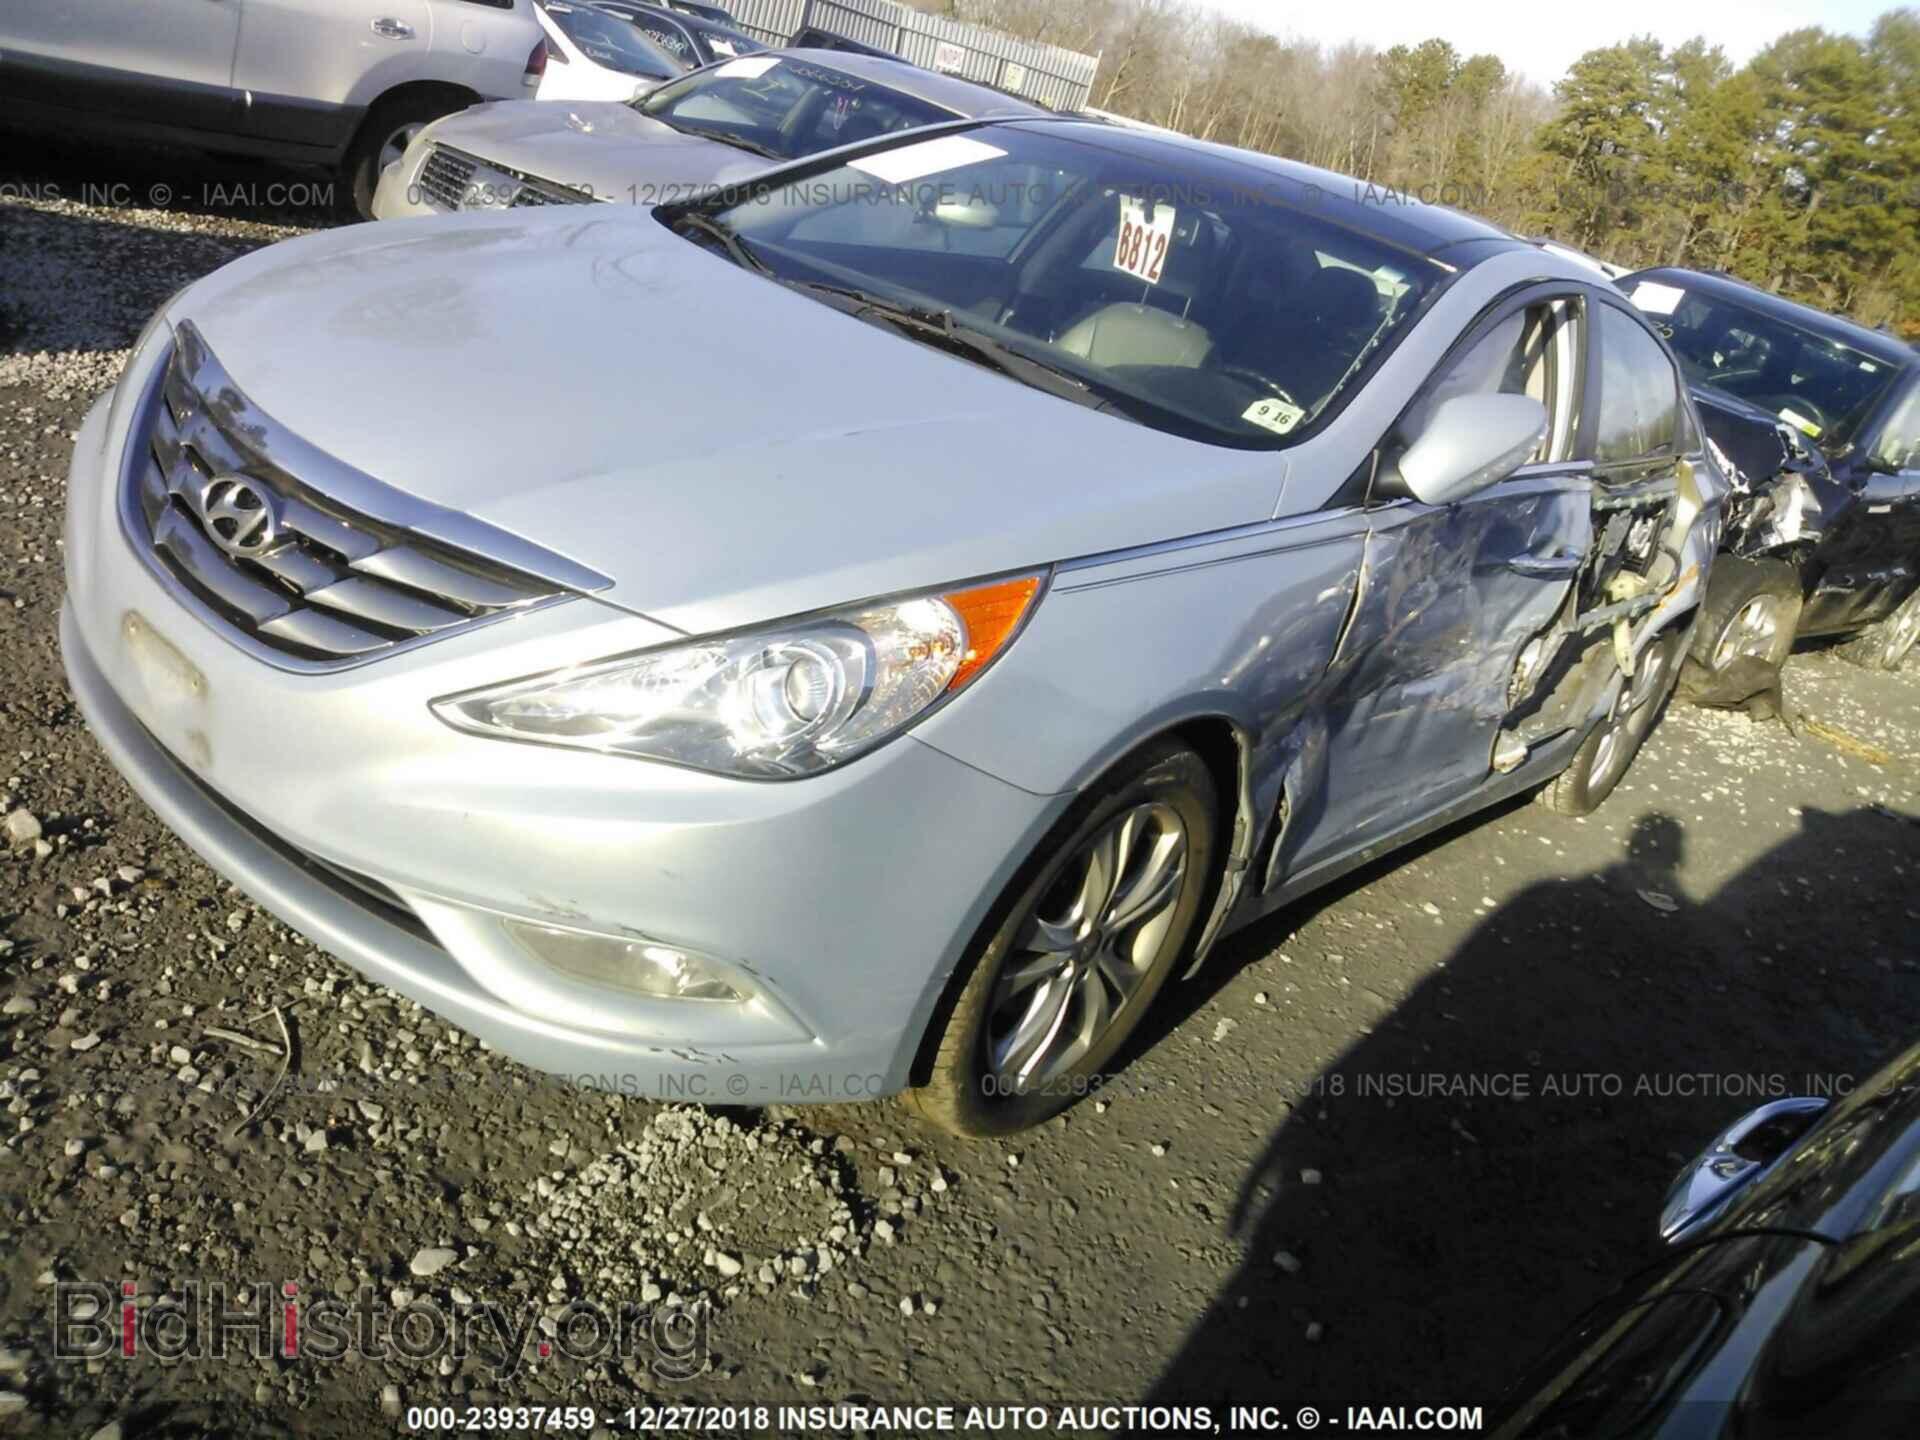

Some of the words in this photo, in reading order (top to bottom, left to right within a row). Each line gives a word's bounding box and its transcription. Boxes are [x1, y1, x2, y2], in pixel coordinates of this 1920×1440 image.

[1118, 221, 1166, 280] 6812
[1258, 405, 1270, 416] 9
[1272, 412, 1291, 425] 16
